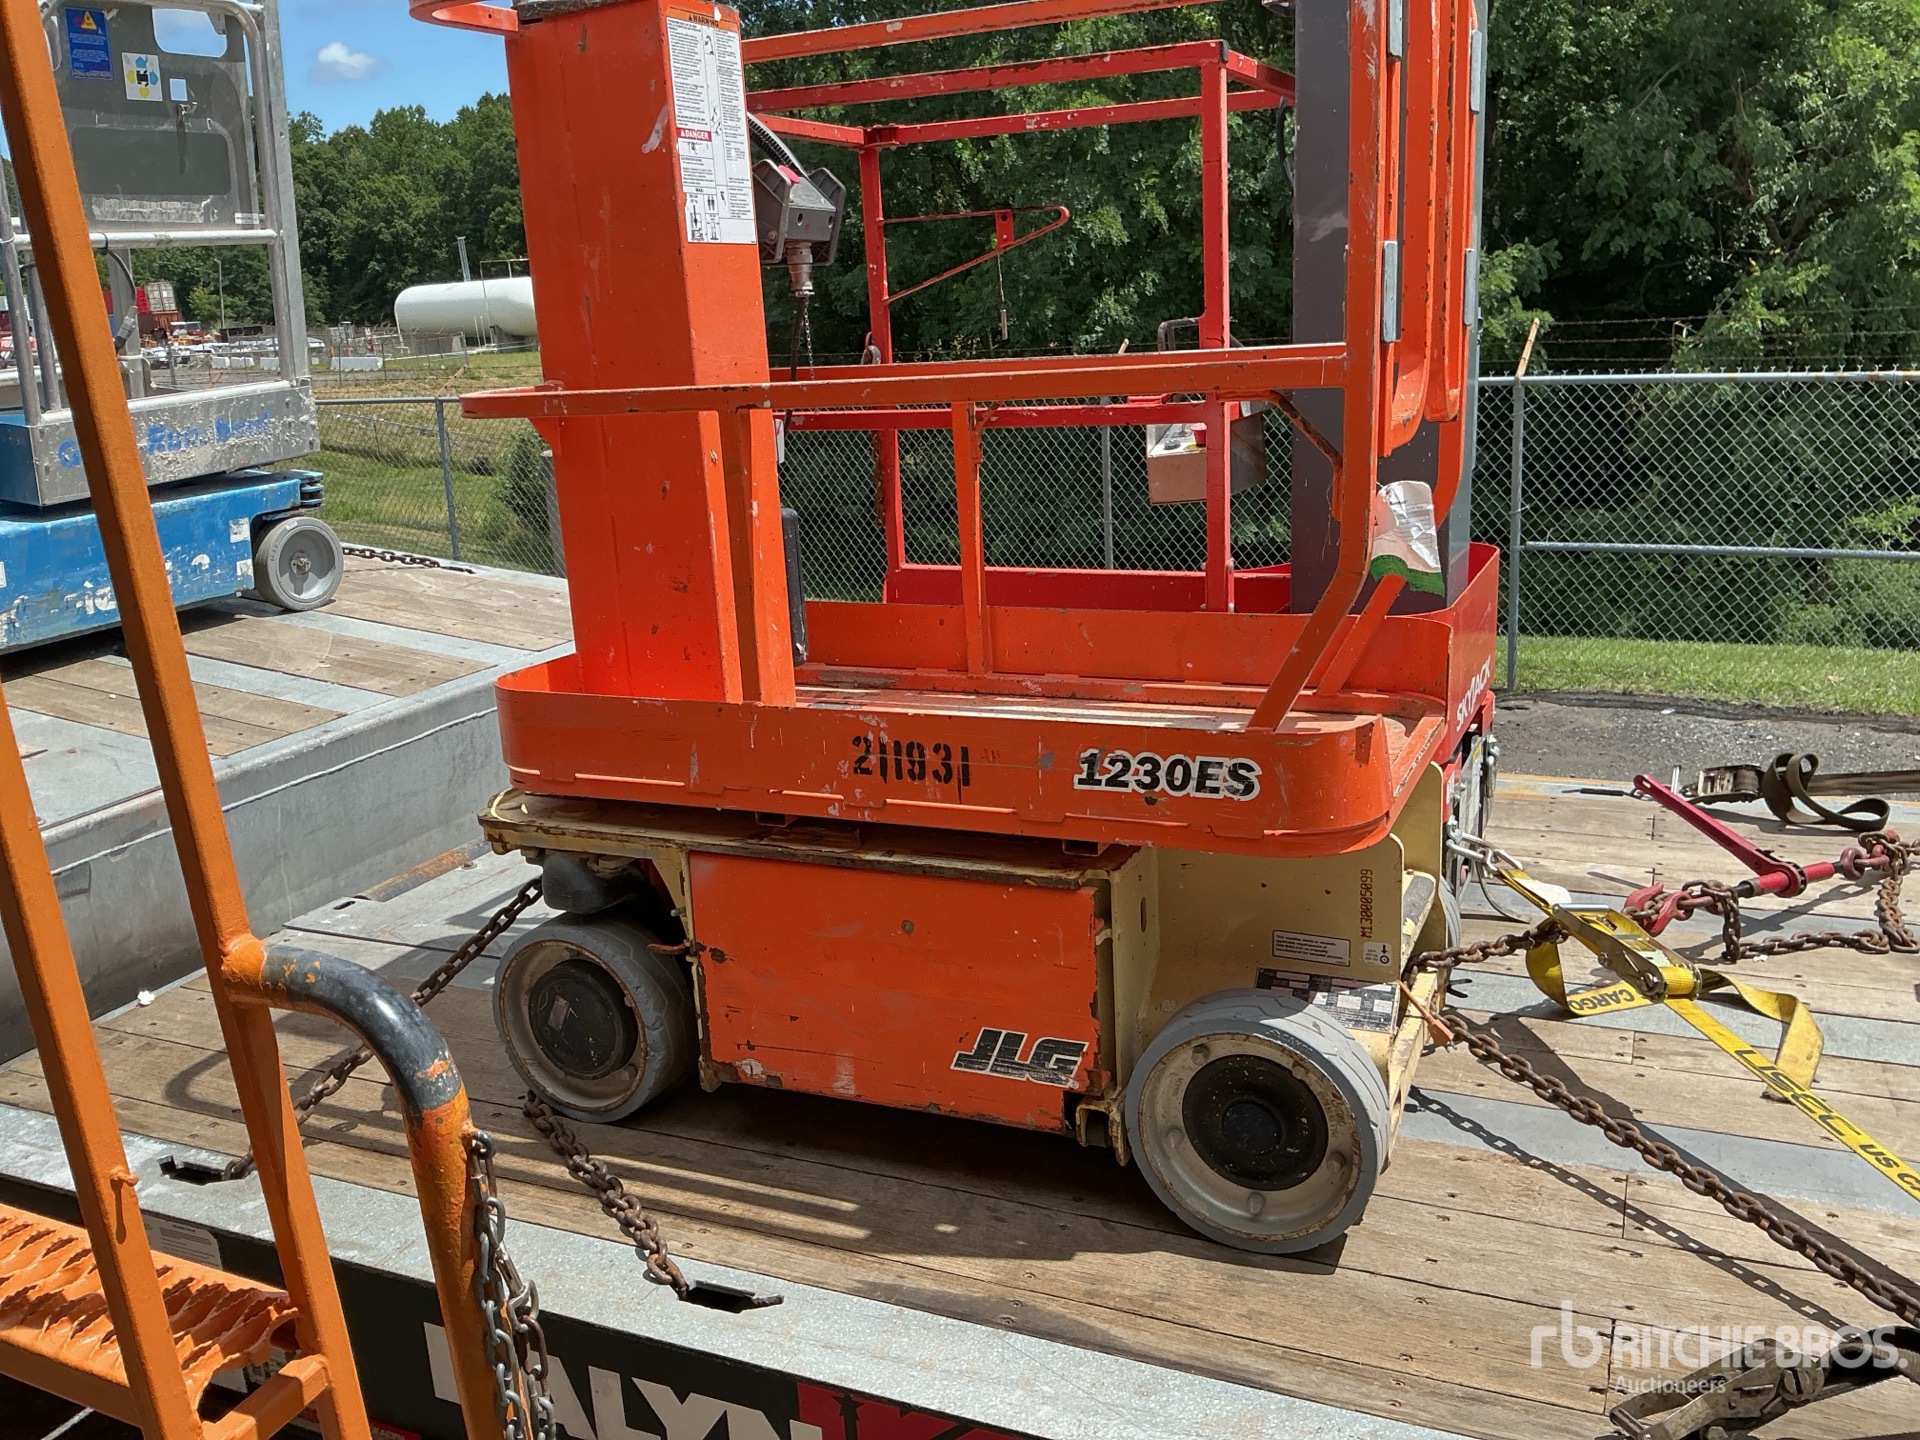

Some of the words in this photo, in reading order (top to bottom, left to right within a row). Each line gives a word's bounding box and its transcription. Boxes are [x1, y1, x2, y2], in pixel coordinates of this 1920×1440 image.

[685, 130, 710, 140] DANGER
[1456, 655, 1491, 732] SKYJACK
[1075, 748, 1261, 801] 1230ES
[1568, 989, 1635, 1011] CARGO
[951, 1027, 1089, 1088] JLG
[1858, 1144, 1899, 1169] US
